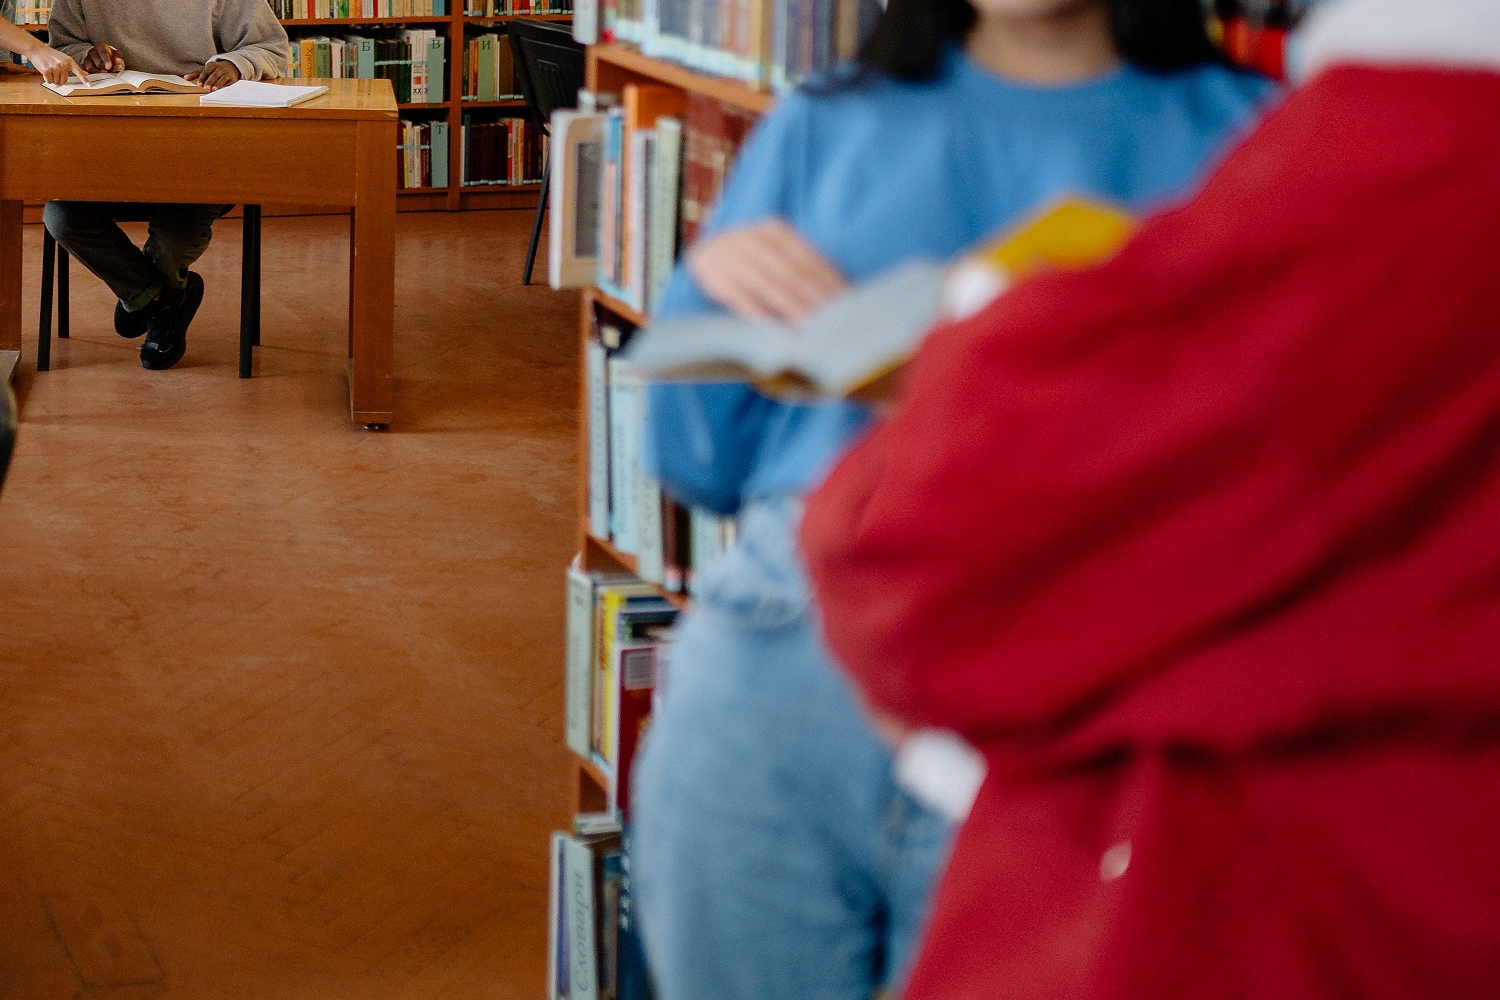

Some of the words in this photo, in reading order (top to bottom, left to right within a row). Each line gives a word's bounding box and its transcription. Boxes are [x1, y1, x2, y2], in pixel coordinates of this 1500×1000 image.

[317, 43, 328, 51] 82
[361, 40, 371, 52] Б
[431, 39, 442, 49] В
[482, 40, 491, 50] И
[435, 124, 444, 135] Т
[573, 870, 589, 992] Словари
